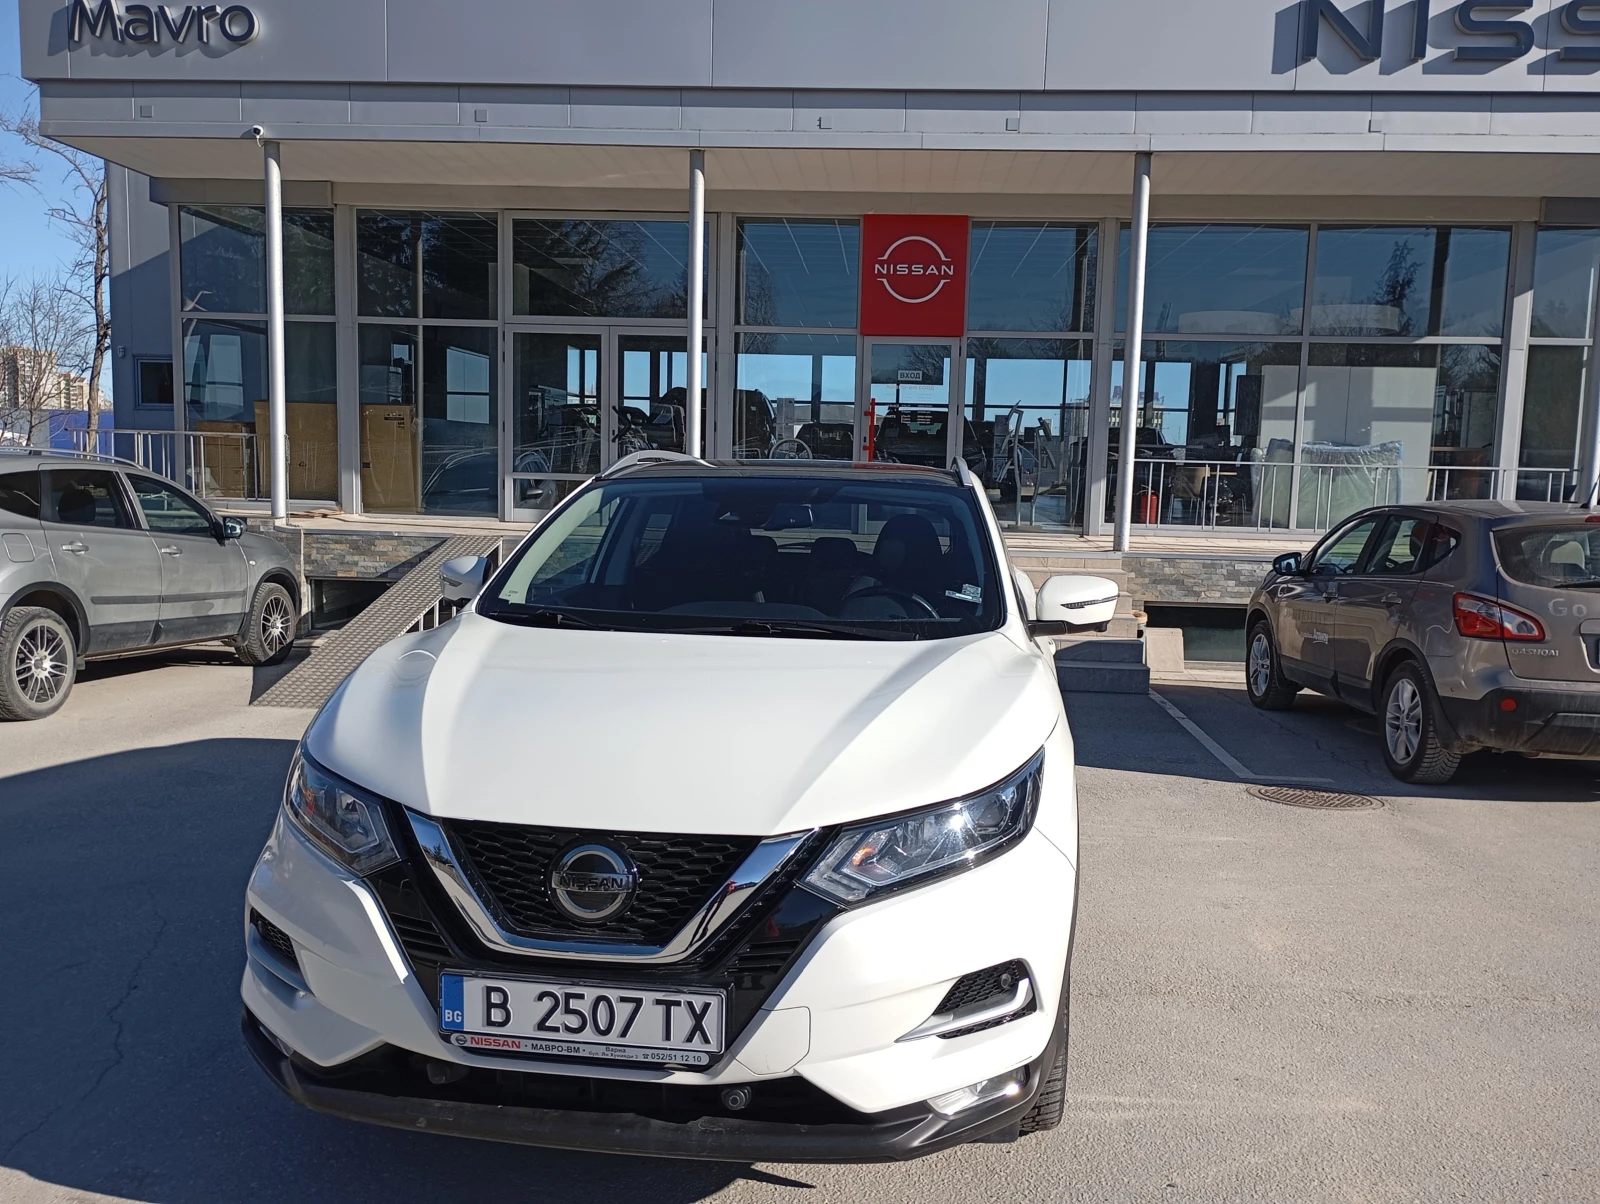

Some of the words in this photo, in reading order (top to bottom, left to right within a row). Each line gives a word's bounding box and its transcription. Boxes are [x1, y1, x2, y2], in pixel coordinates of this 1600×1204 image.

[68, 0, 257, 43] Mavro
[874, 263, 954, 276] NISSAN
[899, 371, 921, 380] ВХОД
[1547, 598, 1587, 617] Go
[1511, 647, 1559, 657] QASHQAI
[560, 875, 624, 890] NISSAN
[444, 1009, 462, 1023] BG
[485, 984, 512, 1027] B
[536, 990, 643, 1039] 2507
[655, 998, 713, 1045] TX
[470, 1036, 521, 1049] NISSAN
[531, 1043, 580, 1054] МАВРО-ВМ
[651, 1052, 677, 1061] 052/51
[692, 1055, 702, 1063] 10
